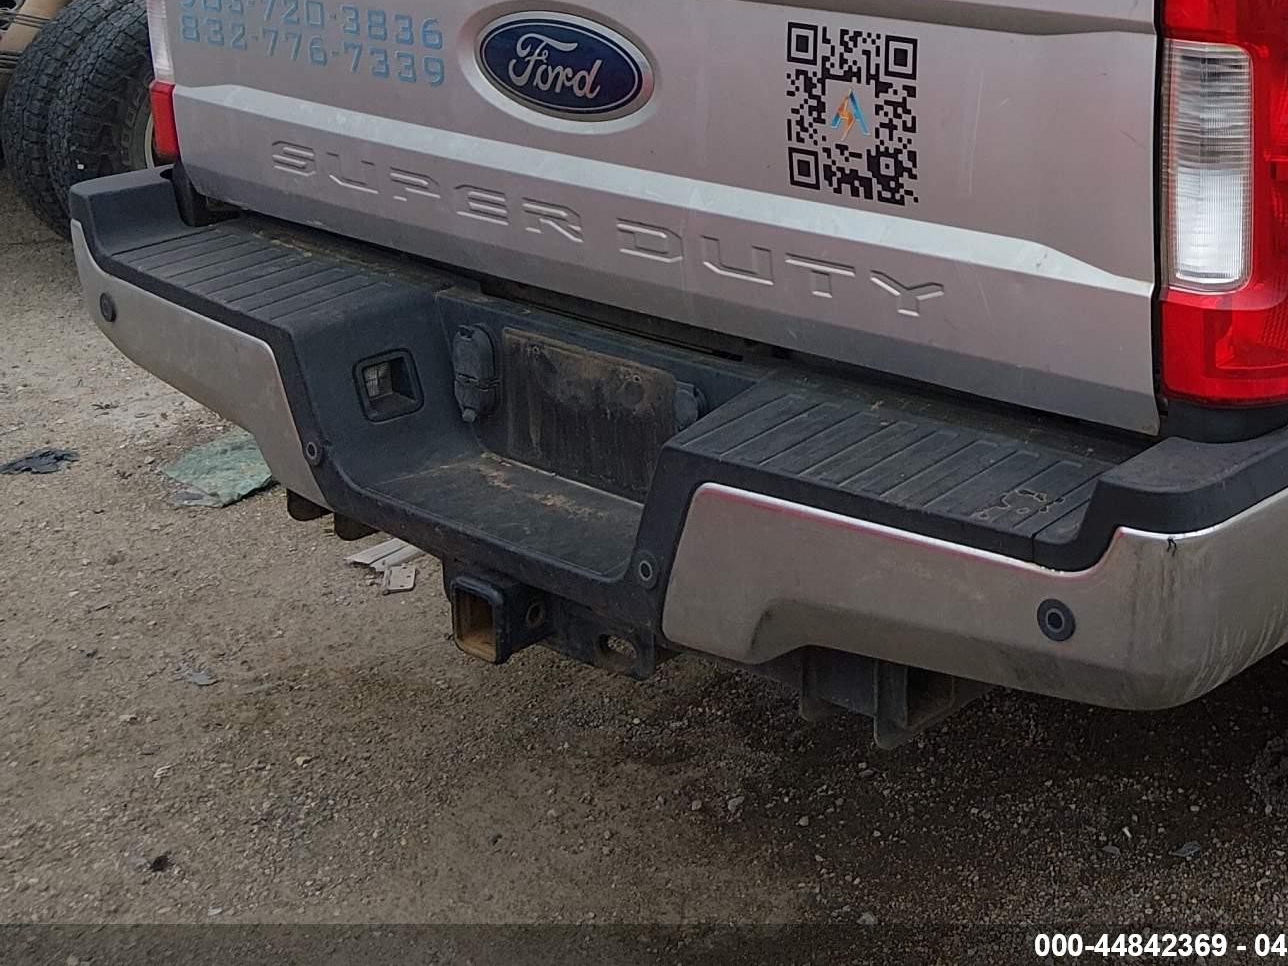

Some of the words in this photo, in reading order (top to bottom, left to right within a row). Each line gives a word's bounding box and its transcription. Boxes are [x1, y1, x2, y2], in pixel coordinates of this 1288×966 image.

[181, 14, 446, 86] 832-776-7339
[508, 33, 603, 99] Ford
[271, 140, 584, 244] SUPER
[615, 217, 945, 318] DUTY
